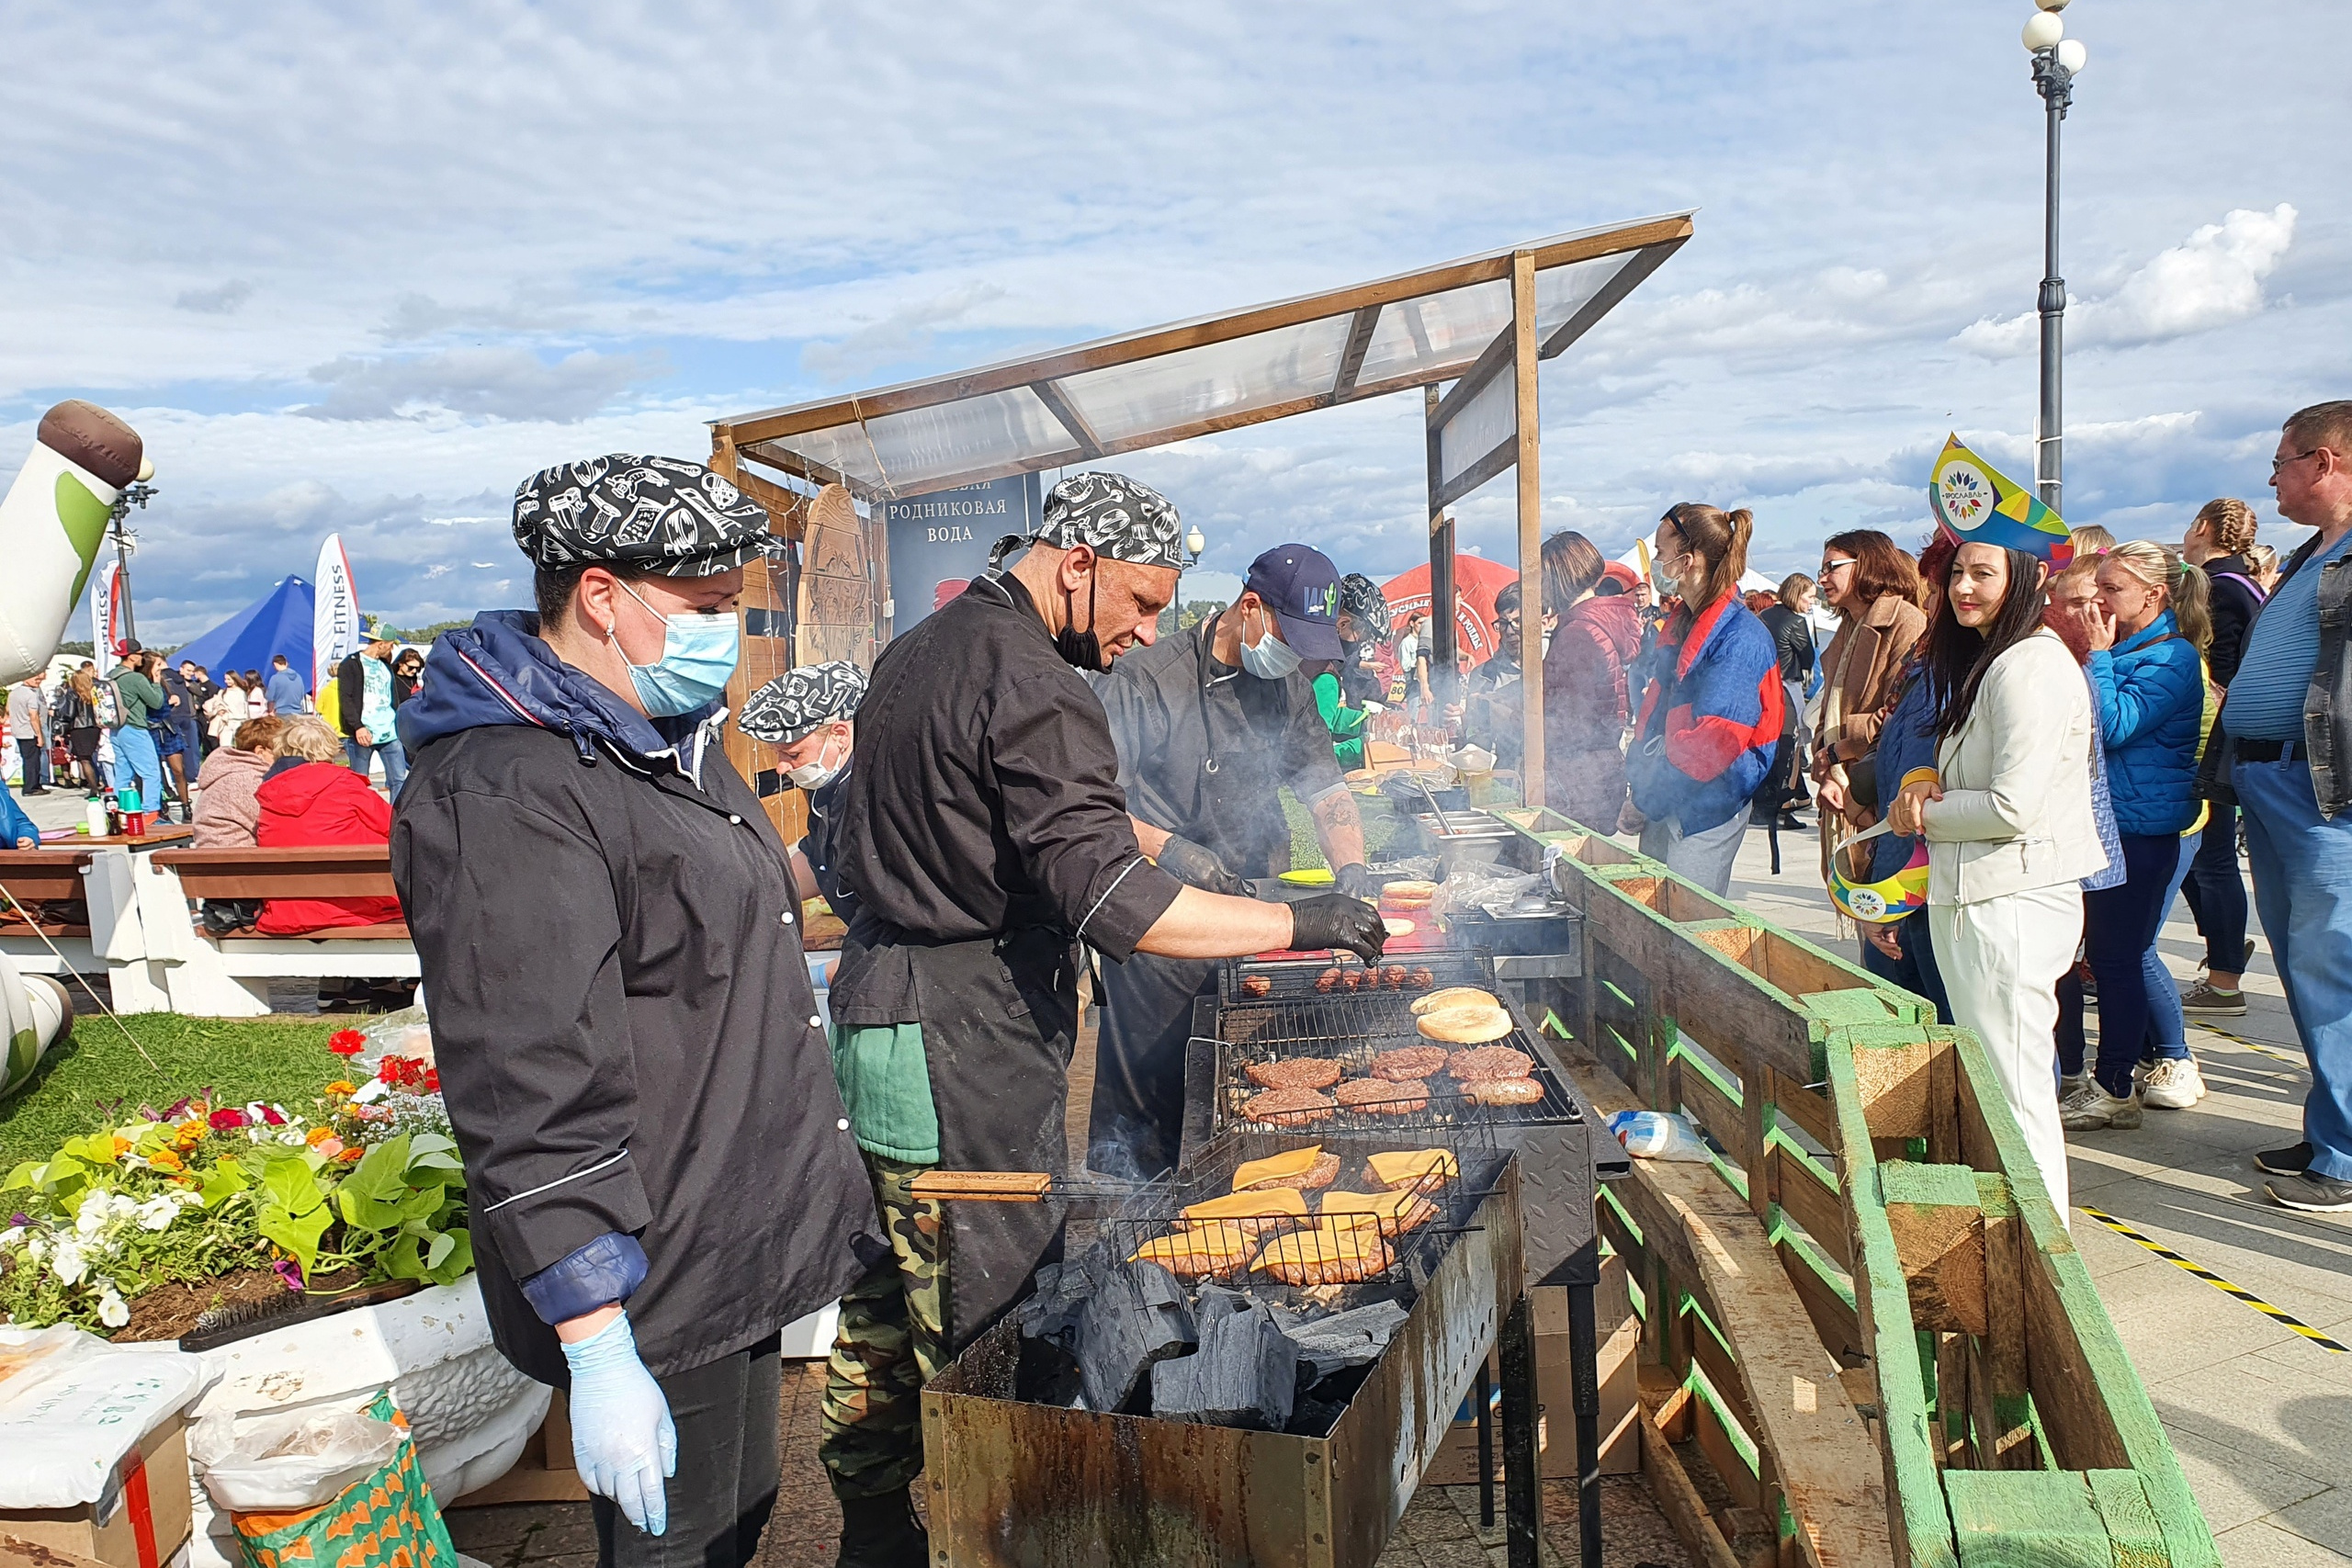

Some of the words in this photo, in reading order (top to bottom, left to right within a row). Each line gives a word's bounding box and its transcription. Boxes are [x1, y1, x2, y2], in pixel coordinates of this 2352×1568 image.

[1945, 491, 1982, 500] ЯРОСЛАВЛЬ
[889, 499, 1007, 521] РОДНИКОВАЯ
[927, 525, 974, 544] ВОДА
[332, 564, 347, 635] FITNESS
